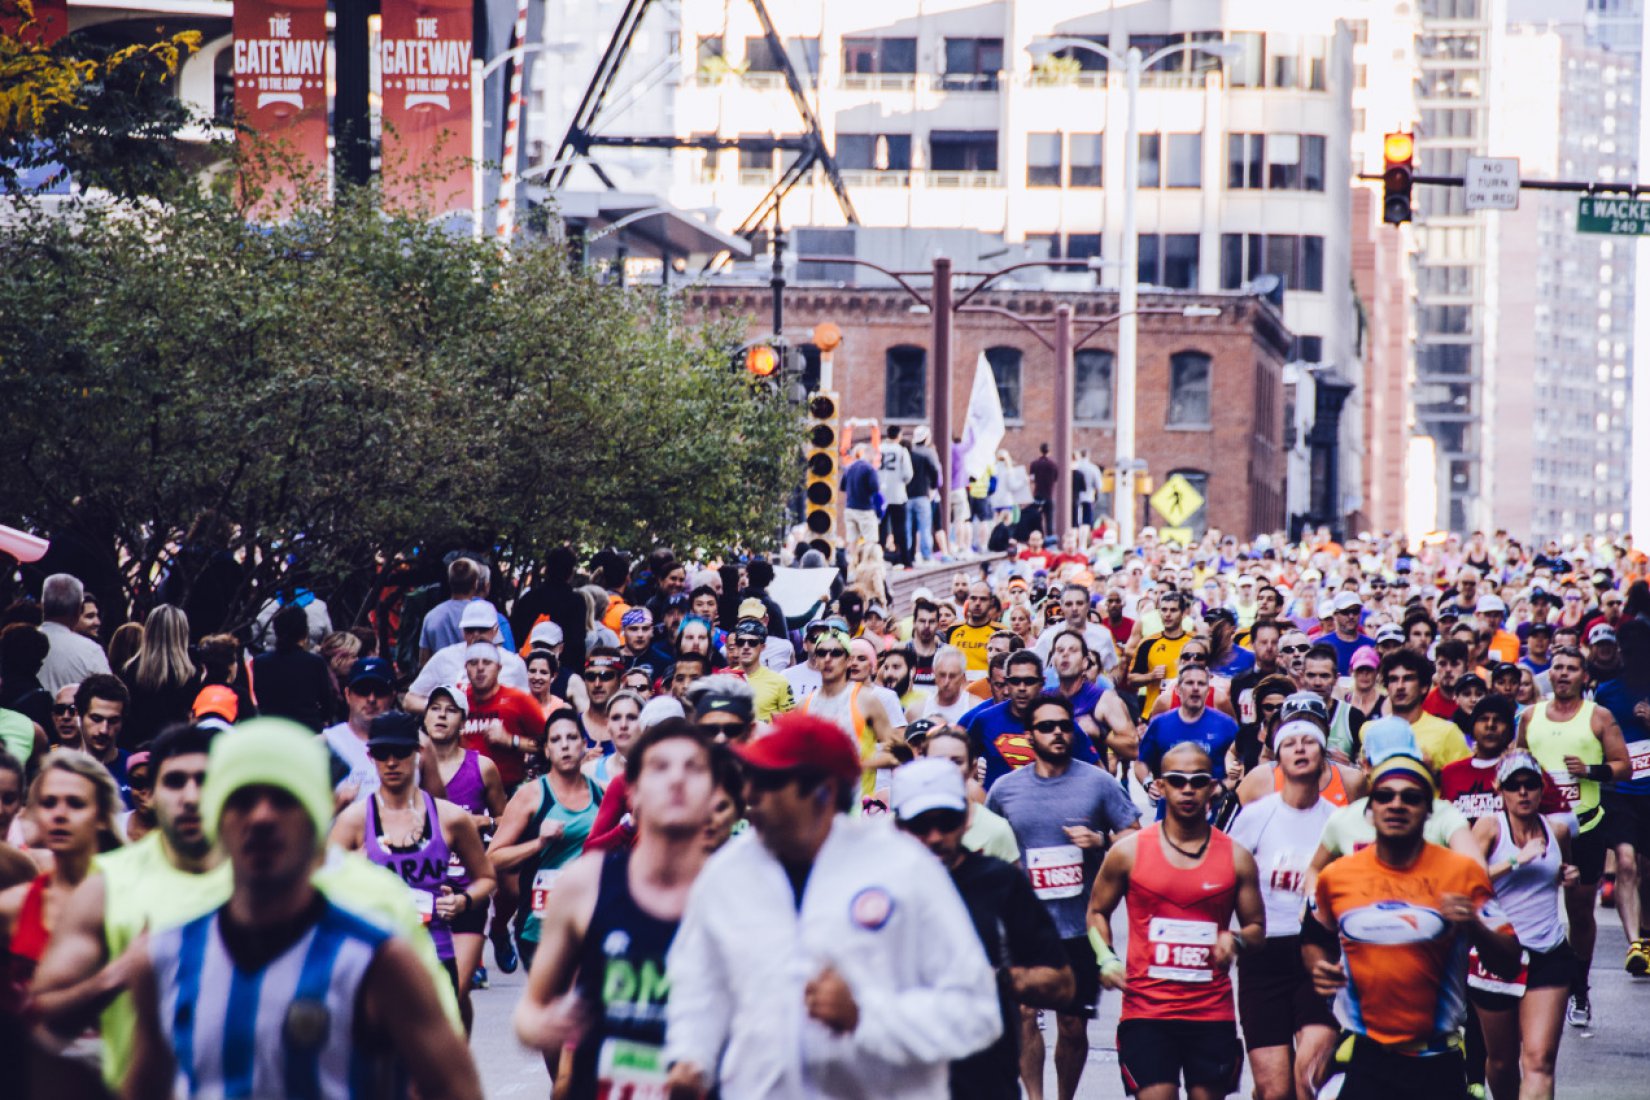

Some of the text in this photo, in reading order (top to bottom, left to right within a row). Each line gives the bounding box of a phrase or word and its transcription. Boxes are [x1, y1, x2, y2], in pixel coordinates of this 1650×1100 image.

[268, 17, 291, 38] THE
[416, 17, 438, 38] THE
[234, 39, 325, 75] GATEWAY
[383, 39, 472, 75] GATEWAY
[1483, 164, 1503, 174] NO
[1478, 177, 1508, 188] TURN
[1469, 193, 1515, 204] ON RED
[1581, 200, 1590, 215] E
[1611, 219, 1638, 234] 240
[1030, 869, 1043, 888] E
